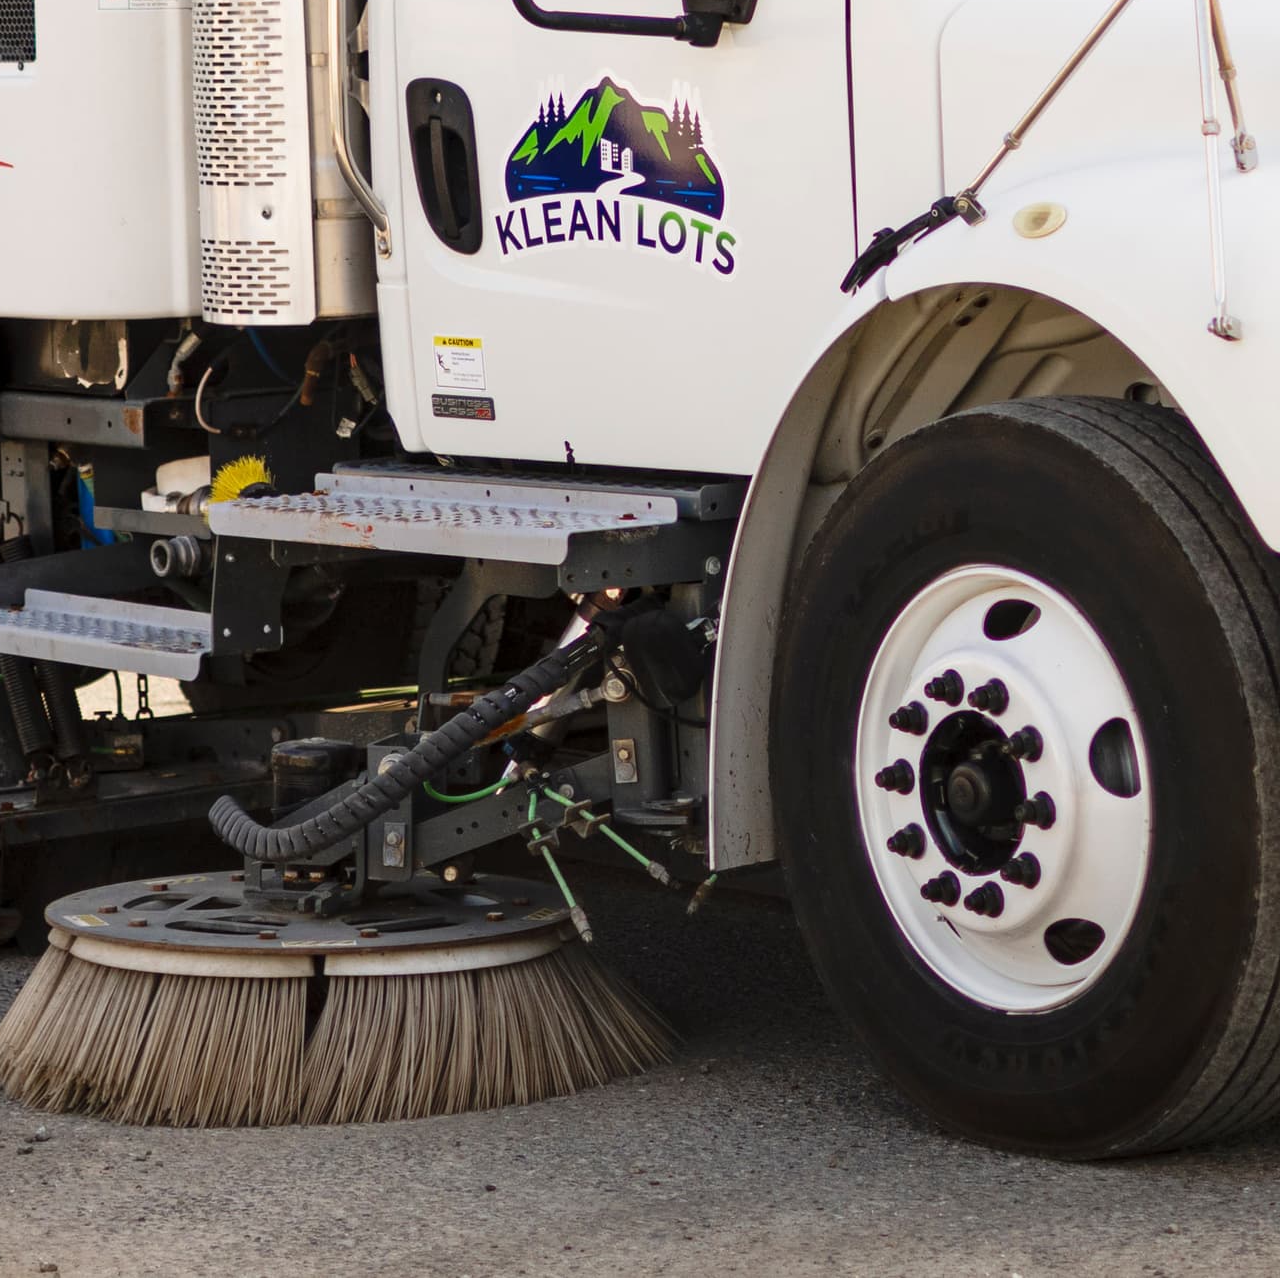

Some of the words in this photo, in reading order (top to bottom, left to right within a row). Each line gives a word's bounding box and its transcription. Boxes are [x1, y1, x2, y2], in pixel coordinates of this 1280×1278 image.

[495, 199, 620, 255] KLEAN
[637, 204, 737, 275] LOTS
[448, 338, 474, 346] CAUTION
